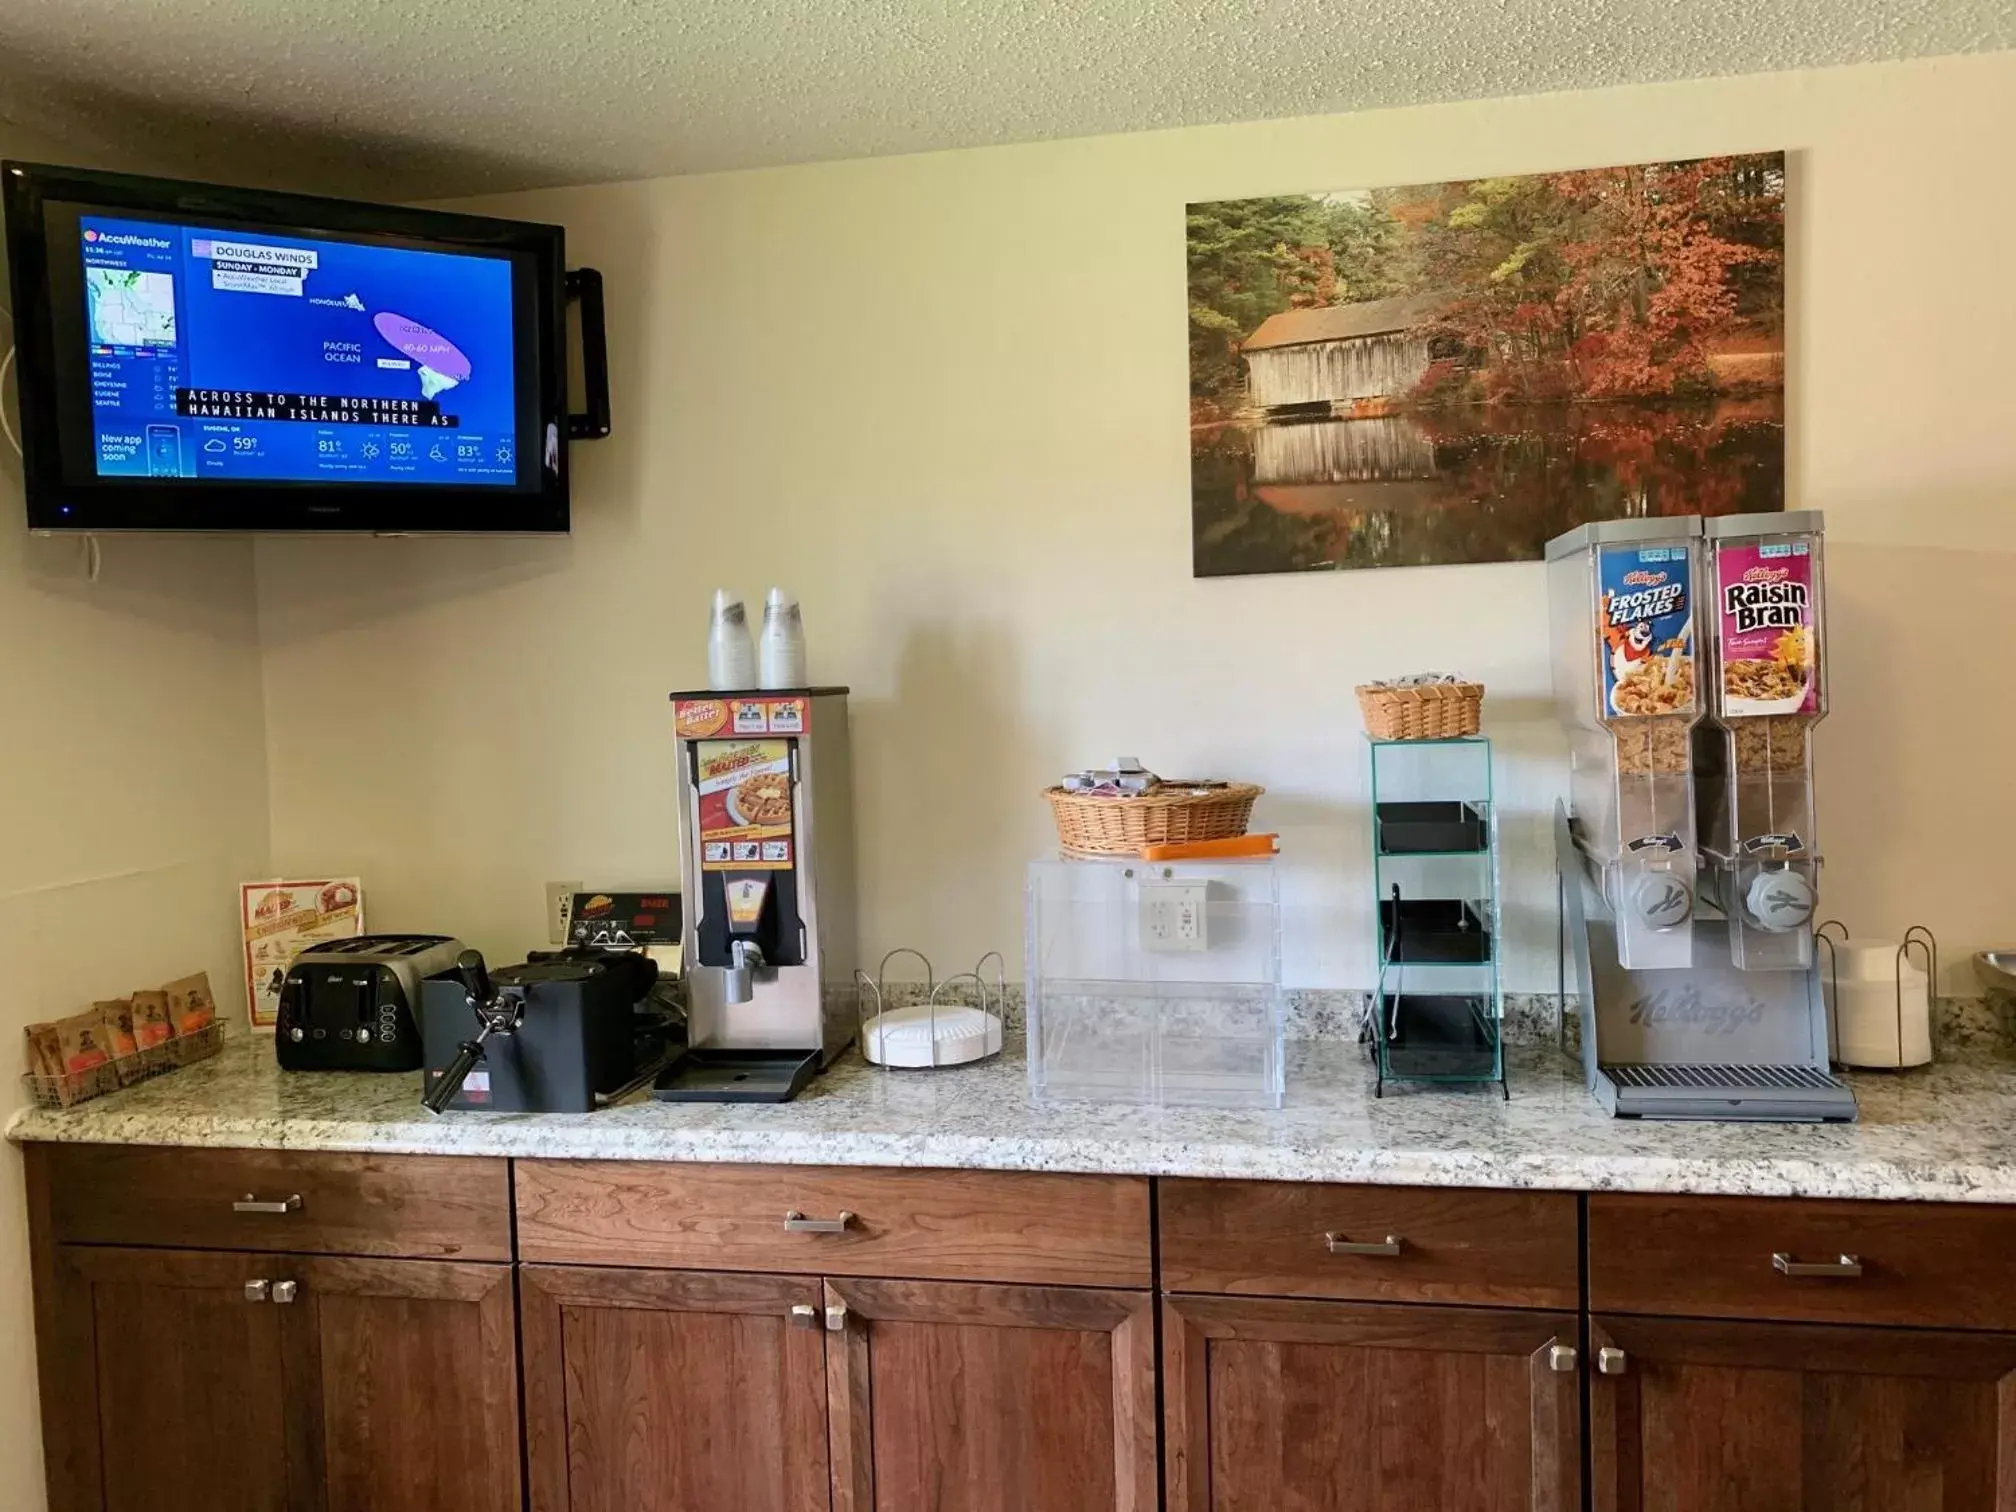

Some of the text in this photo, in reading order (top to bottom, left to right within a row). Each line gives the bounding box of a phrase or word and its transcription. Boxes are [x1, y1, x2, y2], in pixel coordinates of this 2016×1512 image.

[98, 232, 171, 249] AccuWeather
[86, 258, 127, 267] NORTHWEST
[216, 247, 313, 264] DOUGLAS WINDS
[216, 261, 252, 272] SUNDAY
[259, 266, 298, 276] MONDAY
[323, 342, 361, 353] PACIFIC
[324, 353, 361, 363] OCEAN
[188, 390, 419, 412] ACROSS TO THE NORTHERN
[189, 404, 448, 426] HAWAIIAN ISLANDS THERE AS
[101, 434, 142, 445] New app
[102, 444, 137, 455] coming
[103, 453, 126, 461] soon
[1609, 583, 1682, 612] FROSTED
[1727, 583, 1807, 613] Raisin
[1610, 597, 1675, 626] FLAKES
[1737, 605, 1800, 632] Bran
[1629, 983, 1765, 1034] Kellogg's
